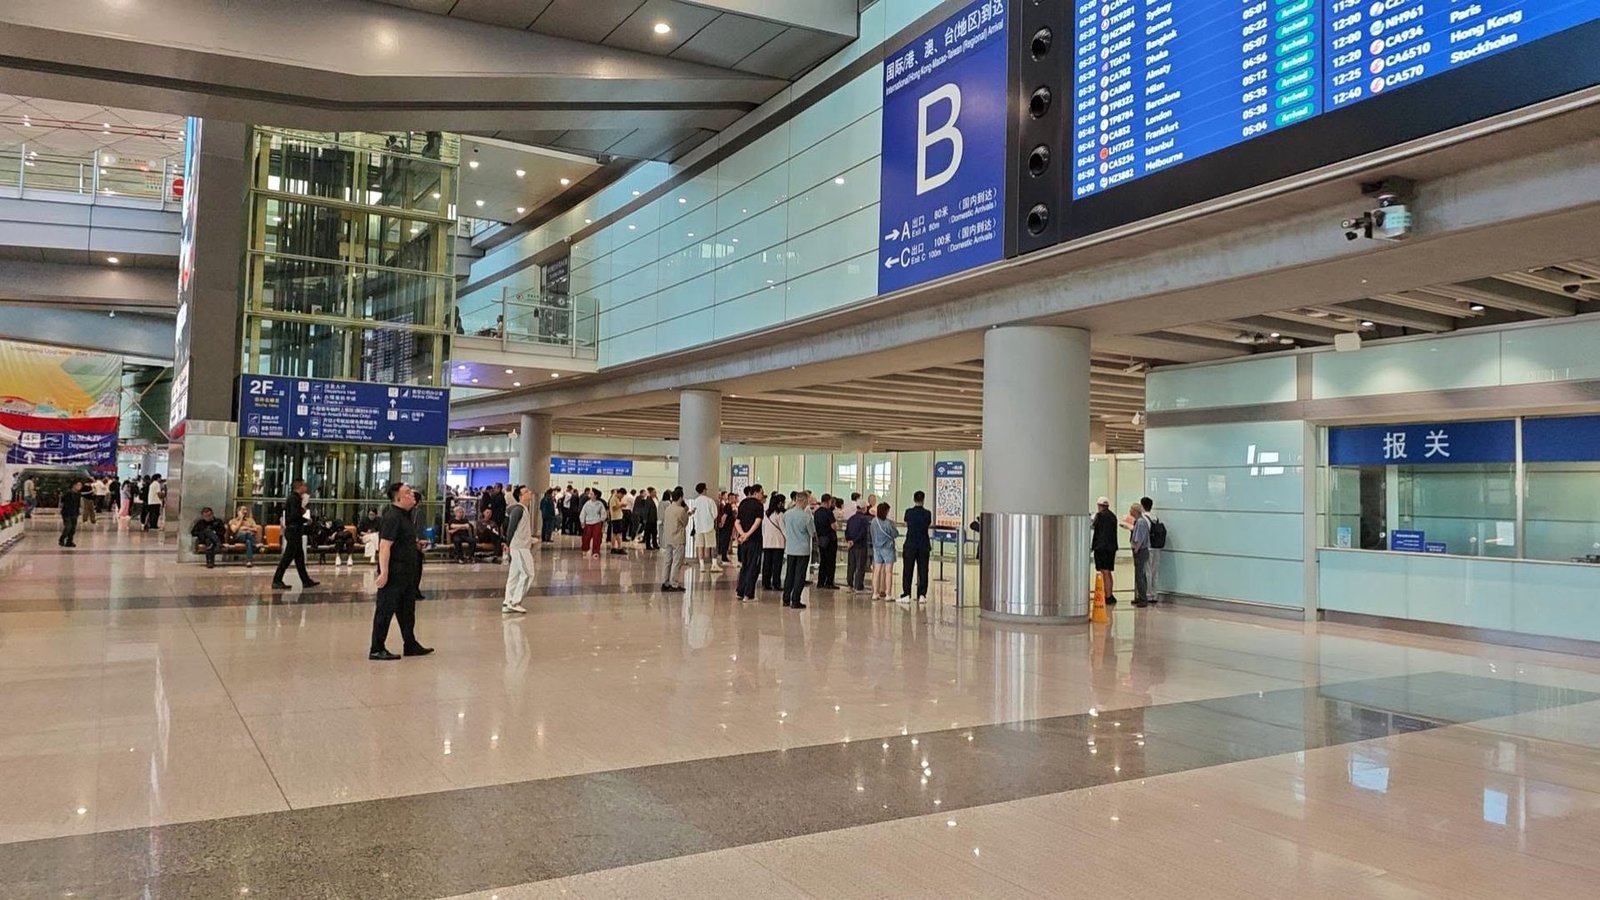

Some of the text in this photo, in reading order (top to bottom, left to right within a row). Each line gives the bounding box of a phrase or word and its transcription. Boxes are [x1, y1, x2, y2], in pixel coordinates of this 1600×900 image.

[1146, 2, 1172, 20] Sydney
[1332, 12, 1361, 31] 12:00
[1332, 30, 1361, 49] 12:00
[1385, 4, 1423, 28] NH961
[1146, 29, 1177, 50] Bangkok
[1332, 4, 1482, 67] 12:20 CA934 Paris
[1145, 63, 1171, 80] Almaty
[1242, 17, 1267, 36] 05:22
[1146, 50, 1169, 65] Dhaka
[1332, 10, 1522, 85] 12:25 CA6510 Hong Kong
[1332, 33, 1519, 104] 12:40 CA570 Stockholm
[1145, 82, 1165, 96] Milan
[1145, 109, 1173, 126] London
[1242, 68, 1267, 87] 05:12
[1145, 91, 1181, 111] Barcelona
[1145, 121, 1179, 141] Frankfurt
[1242, 85, 1267, 103] 05:35
[917, 83, 963, 195] B
[1145, 152, 1184, 171] Melbourne
[1242, 120, 1267, 137] 05:04
[1145, 138, 1174, 155] Istanbul
[901, 221, 910, 241] A
[912, 215, 925, 229] 出口
[901, 247, 910, 267] C
[911, 243, 924, 255] 出口
[250, 379, 273, 395] 2F
[1382, 429, 1451, 460] 报关
